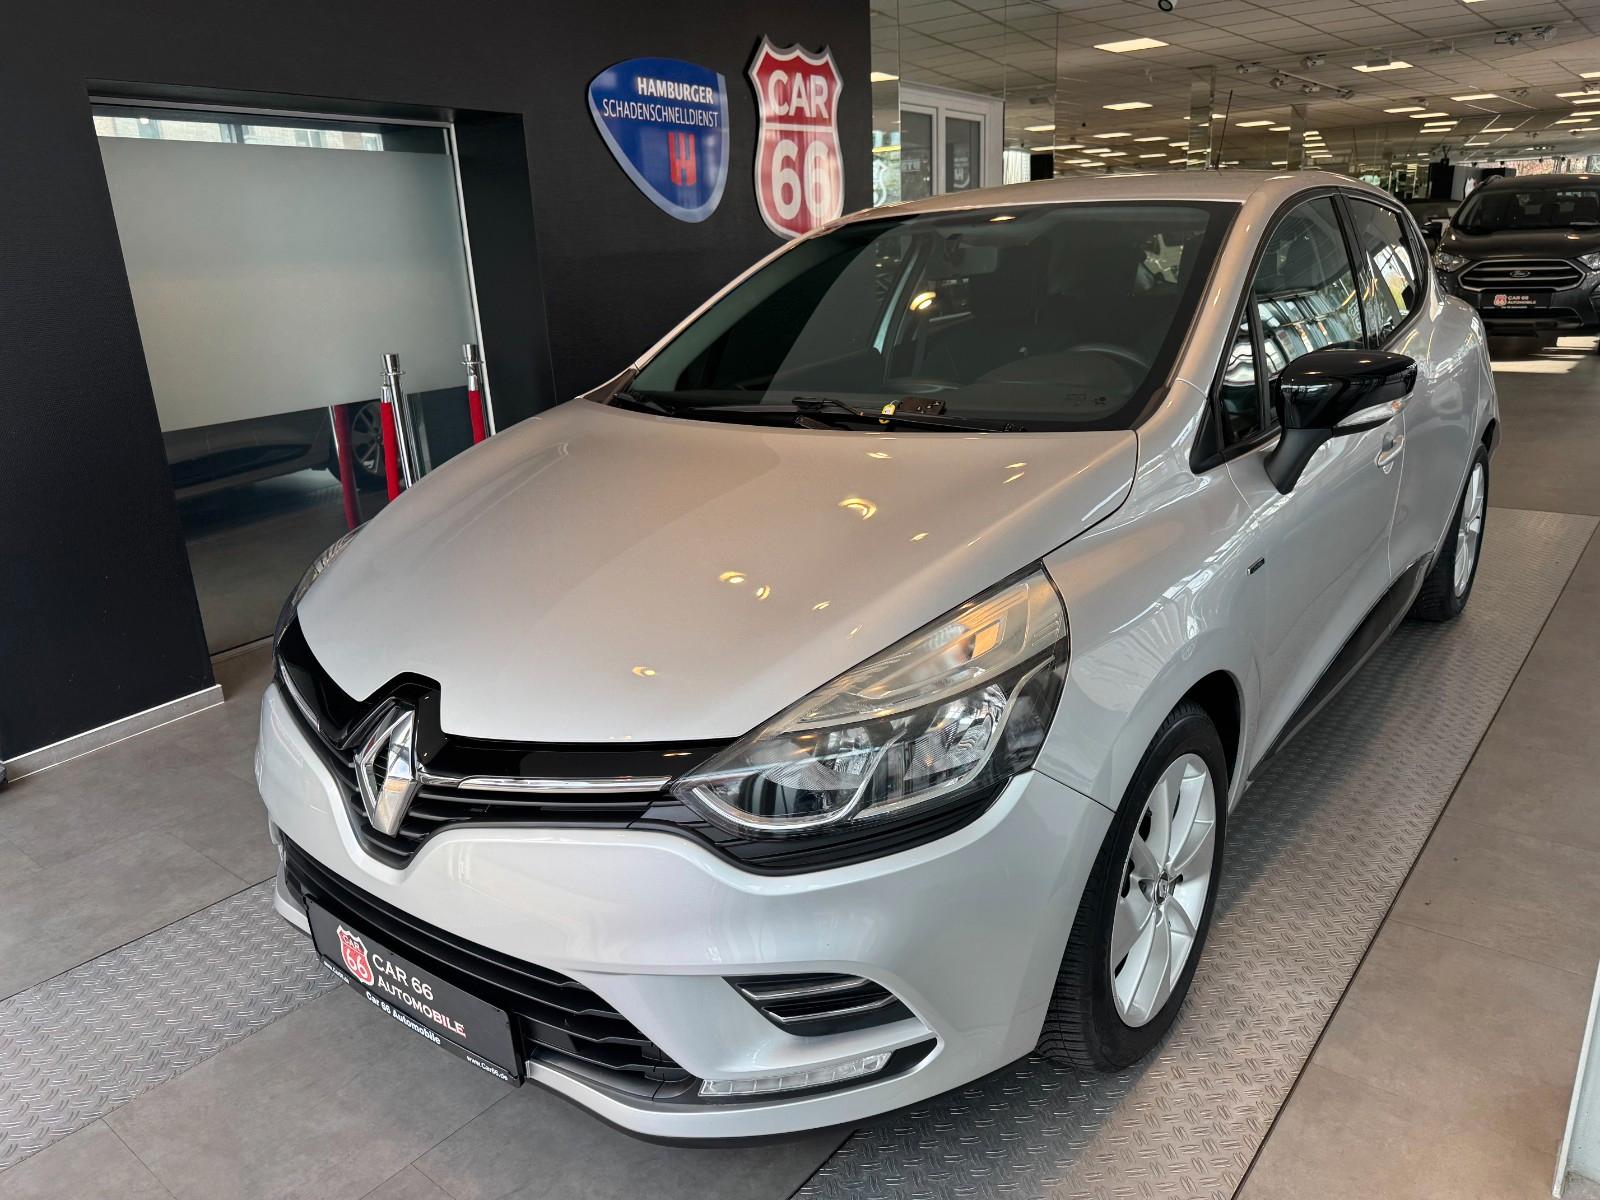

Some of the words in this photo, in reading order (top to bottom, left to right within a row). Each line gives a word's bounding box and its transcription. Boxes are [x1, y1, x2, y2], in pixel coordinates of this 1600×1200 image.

[602, 98, 720, 128] SCHADENSCHNELLDIENST
[638, 77, 714, 105] HAMBURGER
[768, 70, 829, 118] CAR
[771, 138, 831, 220] 66
[343, 934, 361, 951] CAR
[347, 948, 368, 979] 66
[372, 953, 409, 987] CAR
[411, 977, 434, 1001] 66
[366, 991, 381, 1007] Car
[381, 1001, 392, 1015] 66
[392, 1009, 441, 1046] Automobile
[377, 975, 467, 1040] AUTOMOBILE
